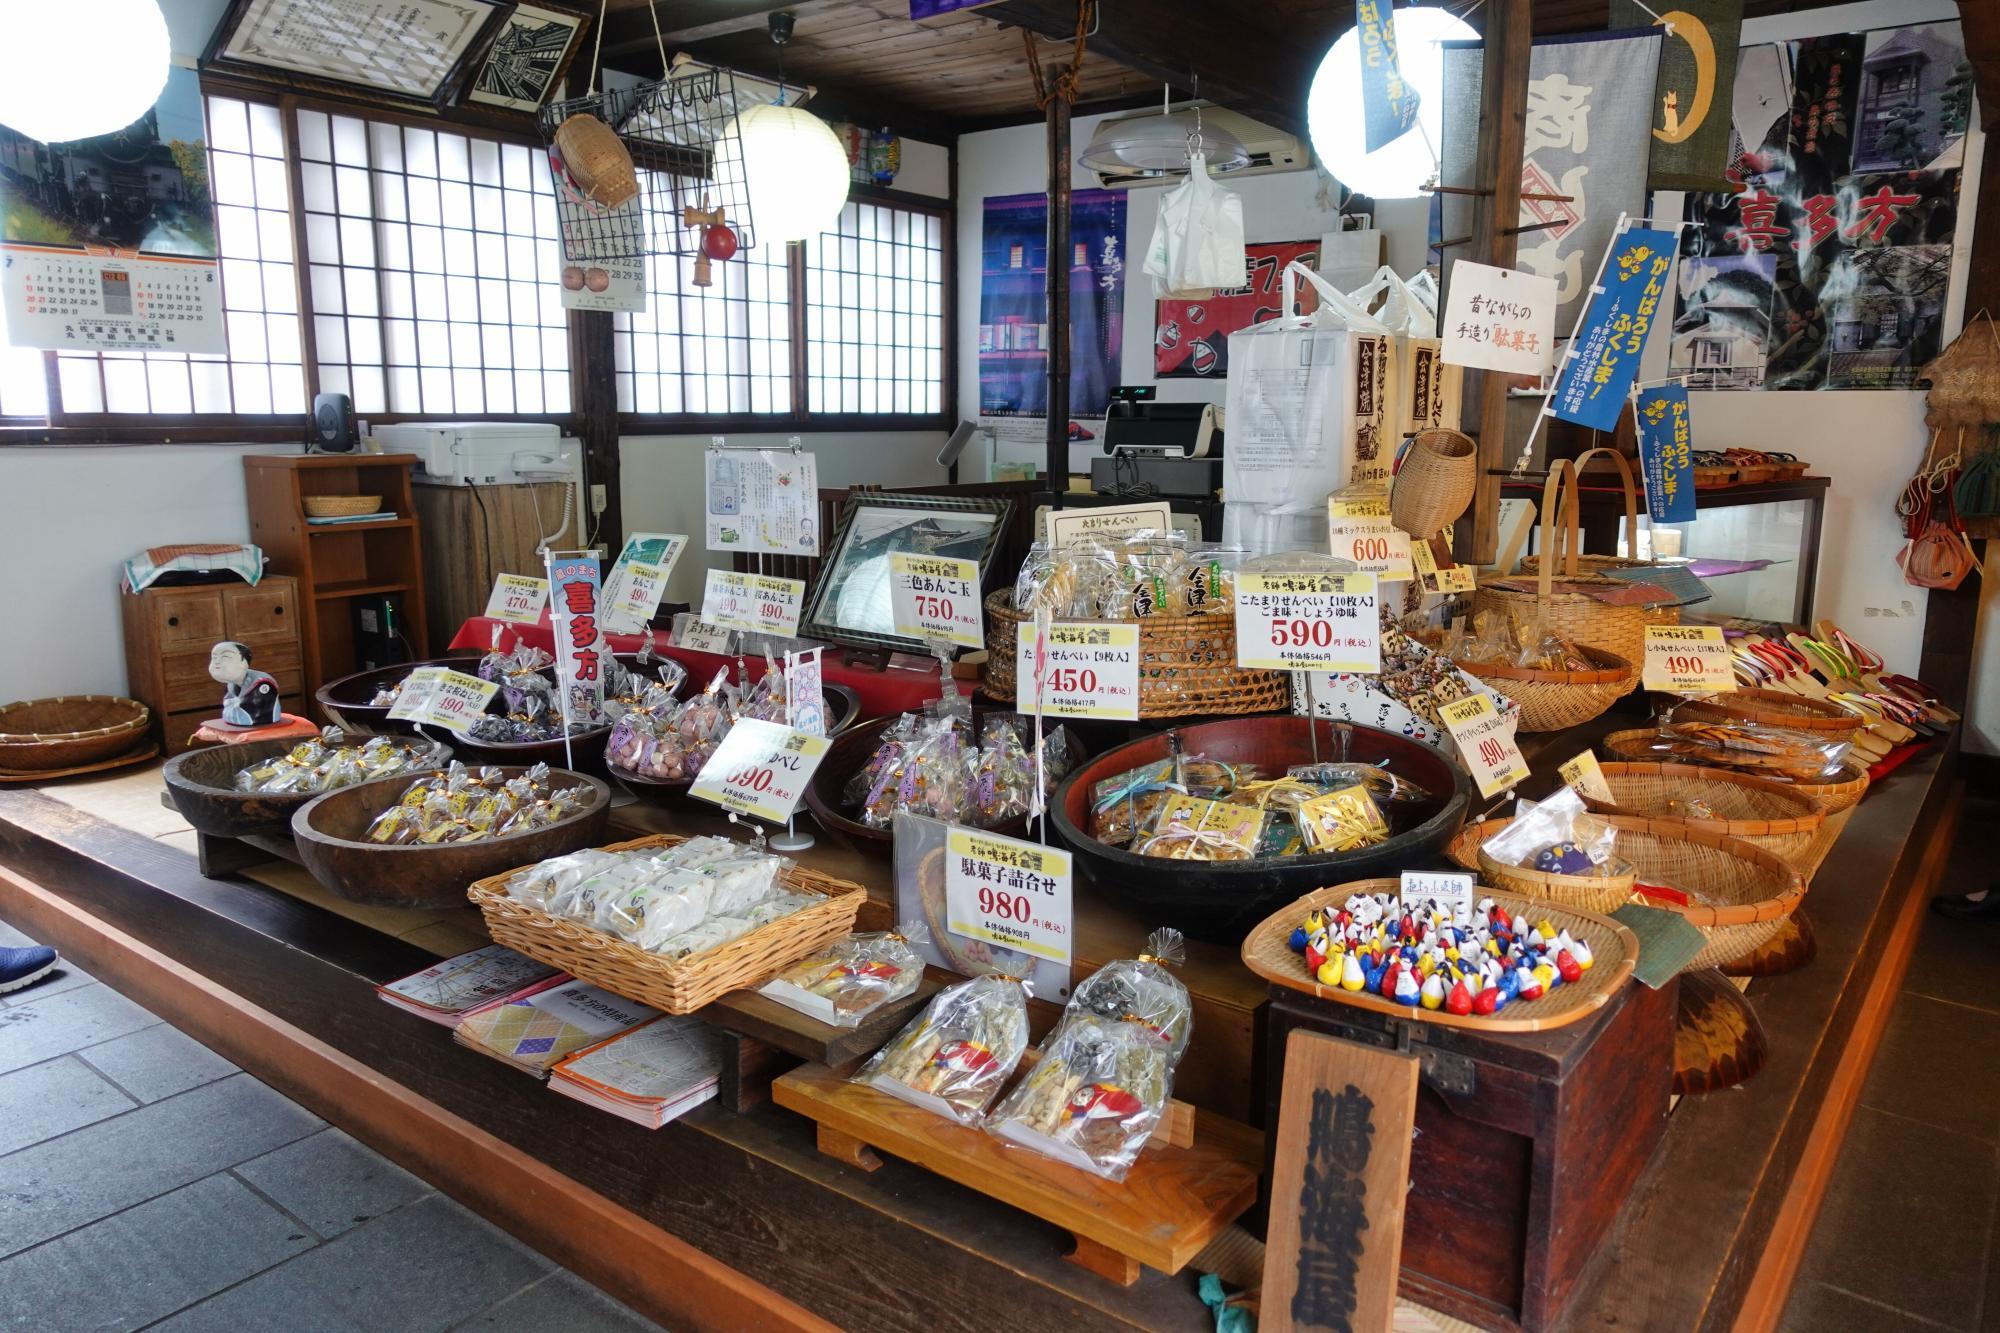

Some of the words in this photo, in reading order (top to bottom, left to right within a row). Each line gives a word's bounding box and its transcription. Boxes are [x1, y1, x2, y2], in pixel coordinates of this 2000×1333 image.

[1723, 185, 1922, 251] 喜多方
[1470, 294, 1531, 320] 昔ながらの
[1625, 255, 1670, 354] がんばろう
[1589, 314, 1632, 400] ふくしま！
[1672, 400, 1689, 469] がんばろう
[1662, 445, 1677, 506] ふくしま！
[1353, 538, 1388, 561] 600
[555, 565, 597, 581] 蔵のまち
[900, 575, 970, 597] 三色あんこ玉
[505, 597, 528, 609] 470
[759, 603, 783, 619] 490
[915, 595, 953, 620] 750
[1240, 595, 1374, 607] こたまりせんべい【10枚入】
[1261, 607, 1358, 618] ごま味・しょうゆ味
[563, 581, 599, 681] 喜多方
[1271, 620, 1333, 647] 590
[1280, 652, 1331, 661] 本体価格546円
[1664, 656, 1704, 674] 490
[1046, 668, 1097, 692] 450
[439, 696, 464, 714] 490
[1052, 698, 1096, 707] 本体価格417円
[1479, 738, 1505, 767] 490
[961, 857, 1056, 896] 駄菓子詰合せ
[979, 887, 1031, 923] 980
[984, 921, 1030, 940] 本体価格908円
[561, 987, 640, 1028] 喜多方の特産品
[1290, 1083, 1376, 1333] 鳴海屋
